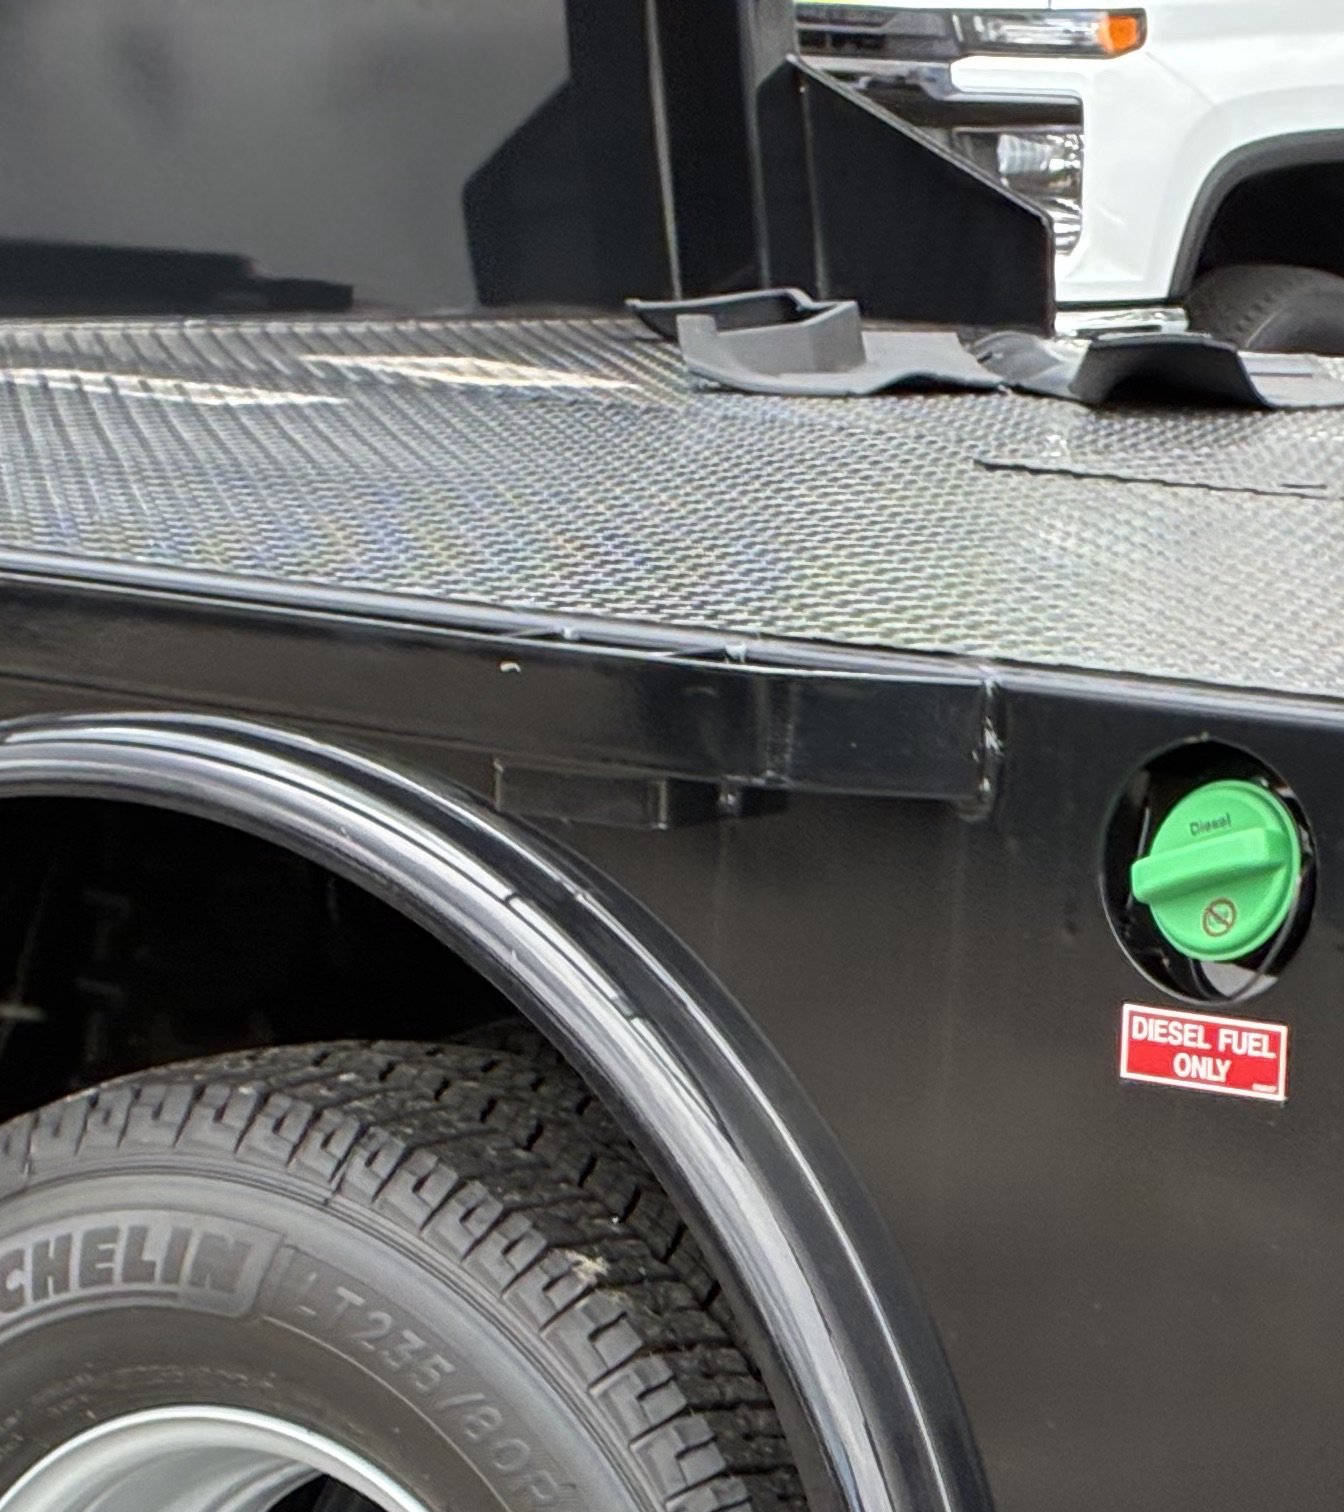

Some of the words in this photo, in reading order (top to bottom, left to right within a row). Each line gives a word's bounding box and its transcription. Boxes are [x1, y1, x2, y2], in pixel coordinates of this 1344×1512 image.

[1188, 812, 1232, 836] Diesel
[1131, 1015, 1212, 1050] DIESEL
[1218, 1028, 1277, 1059] FUEL
[1173, 1052, 1233, 1083] ONLY
